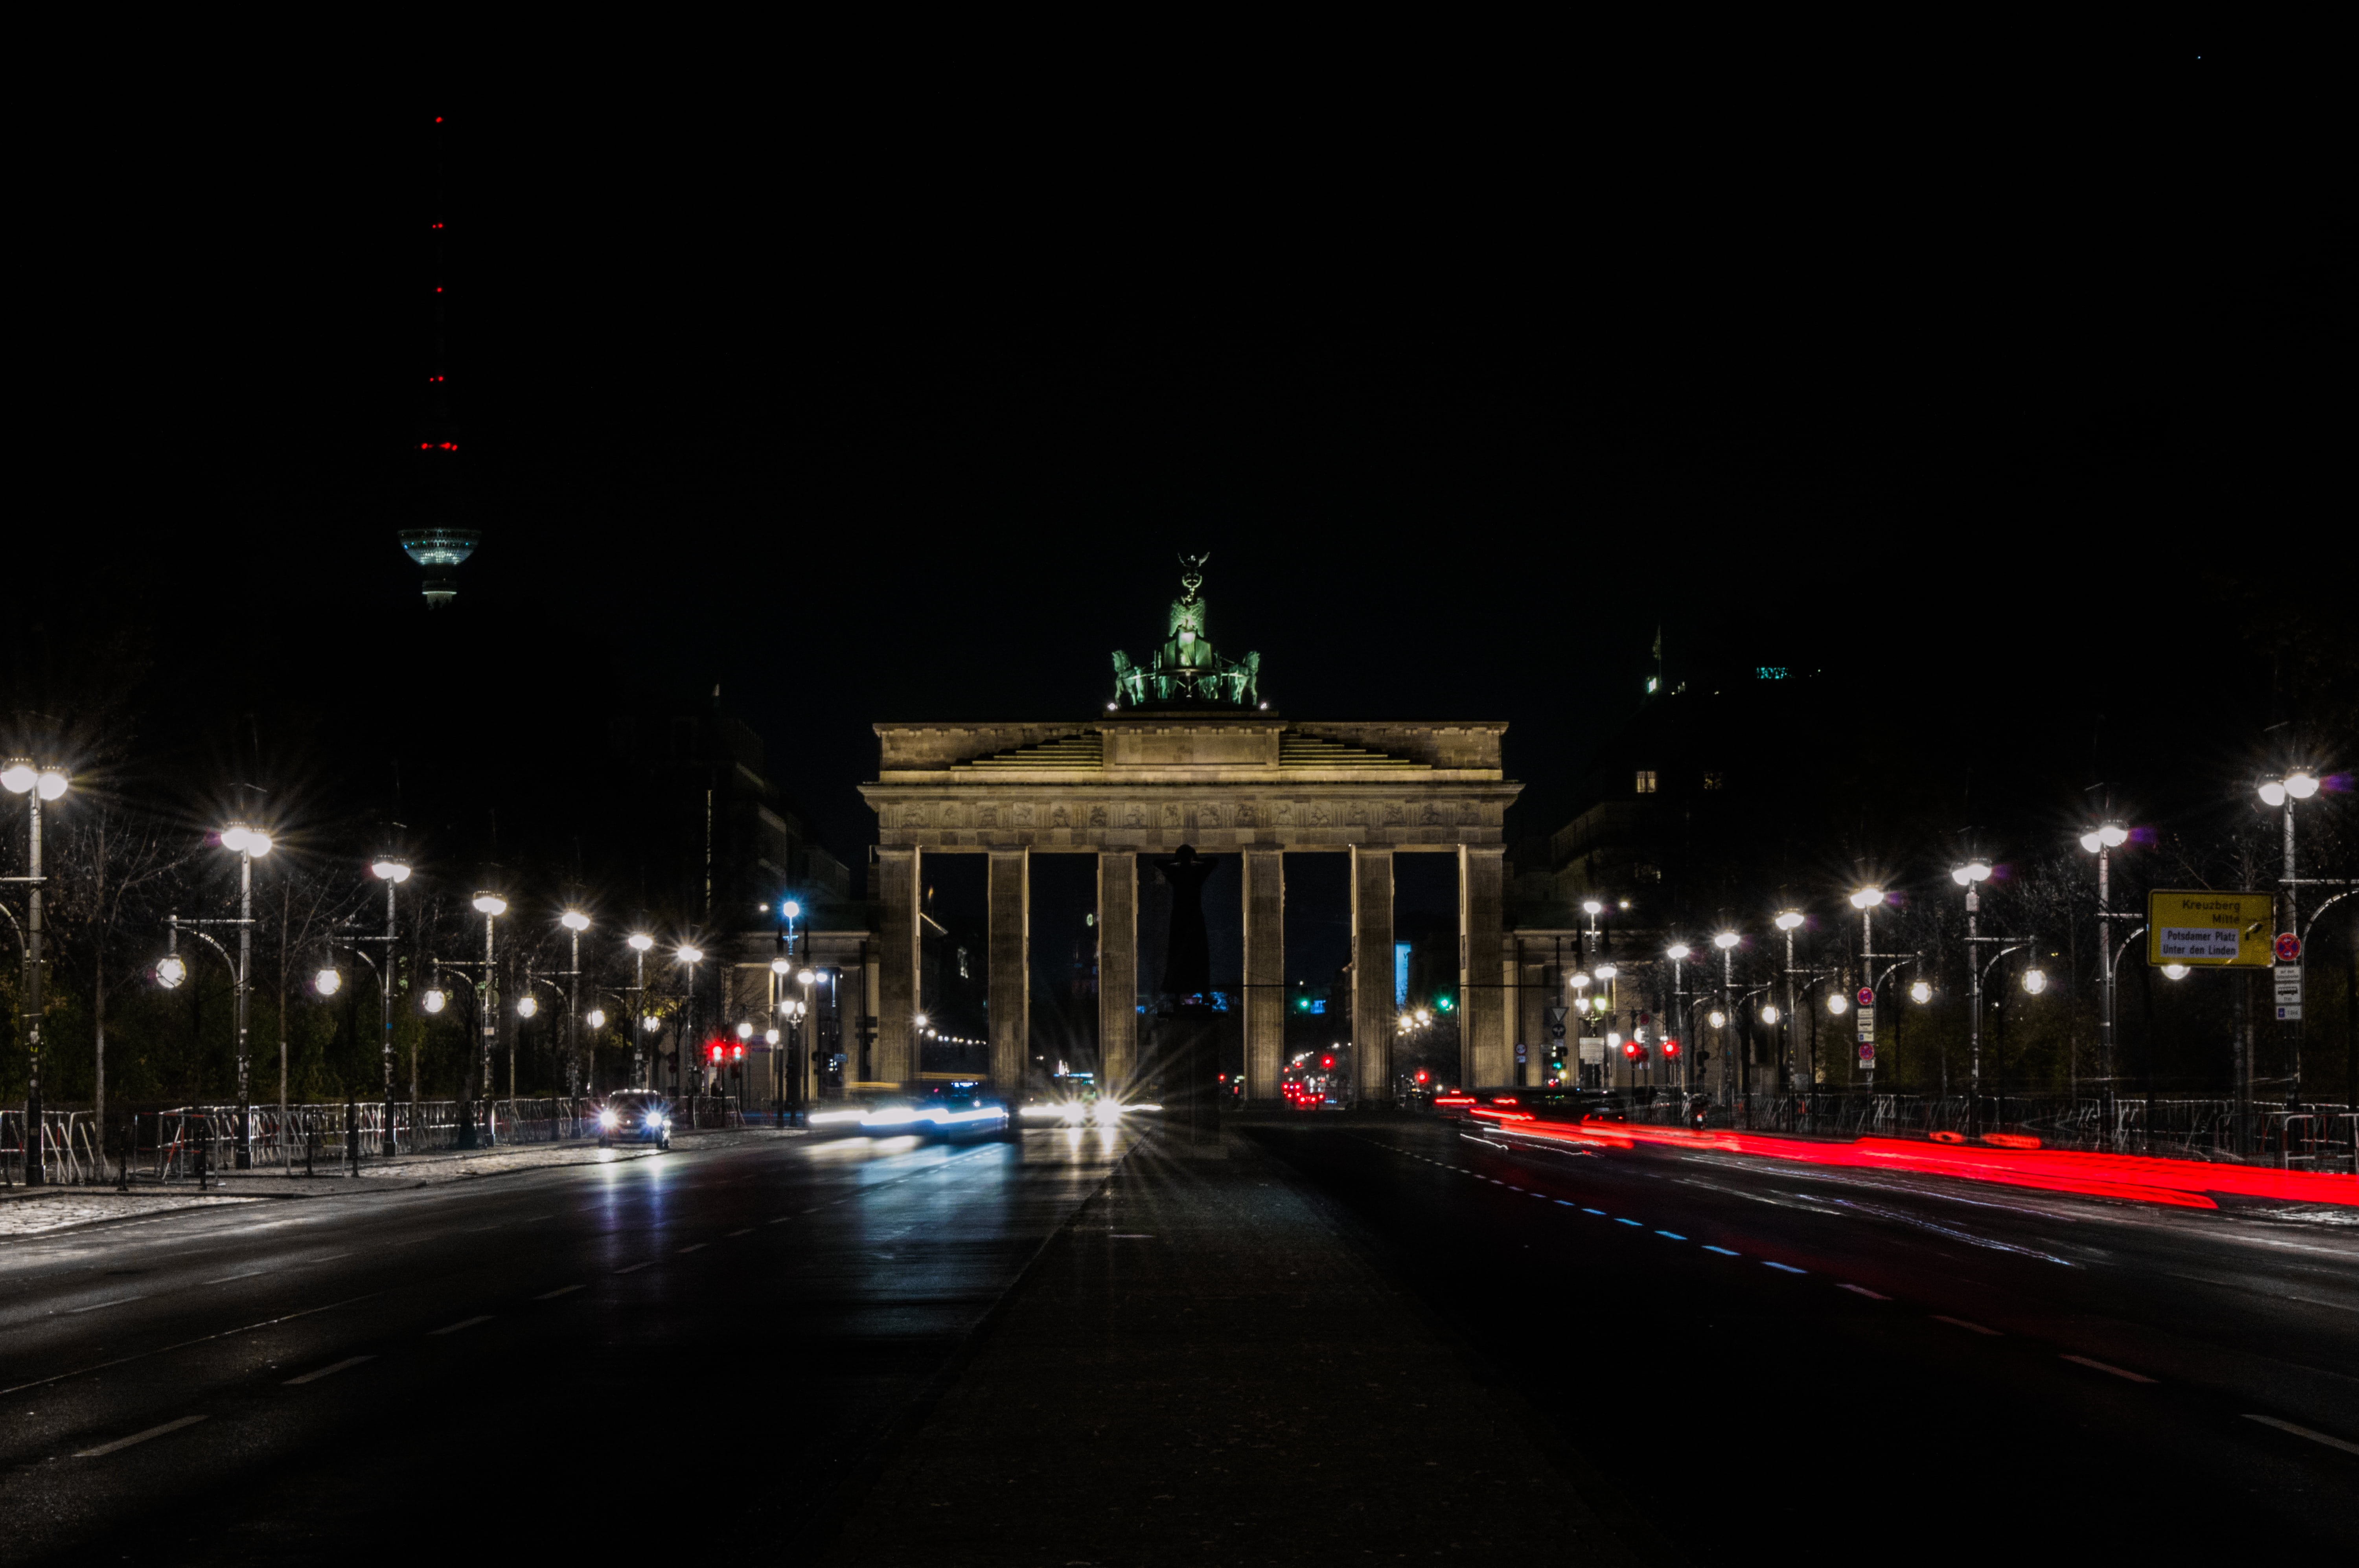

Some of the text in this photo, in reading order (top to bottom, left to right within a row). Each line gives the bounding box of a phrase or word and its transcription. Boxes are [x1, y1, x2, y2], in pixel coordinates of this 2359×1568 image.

[2182, 900, 2240, 912] Kreuzberg
[2212, 914, 2240, 923] Mitte
[2168, 931, 2236, 941] Potsdamer Platz
[2163, 945, 2236, 955] Unter den Linden
